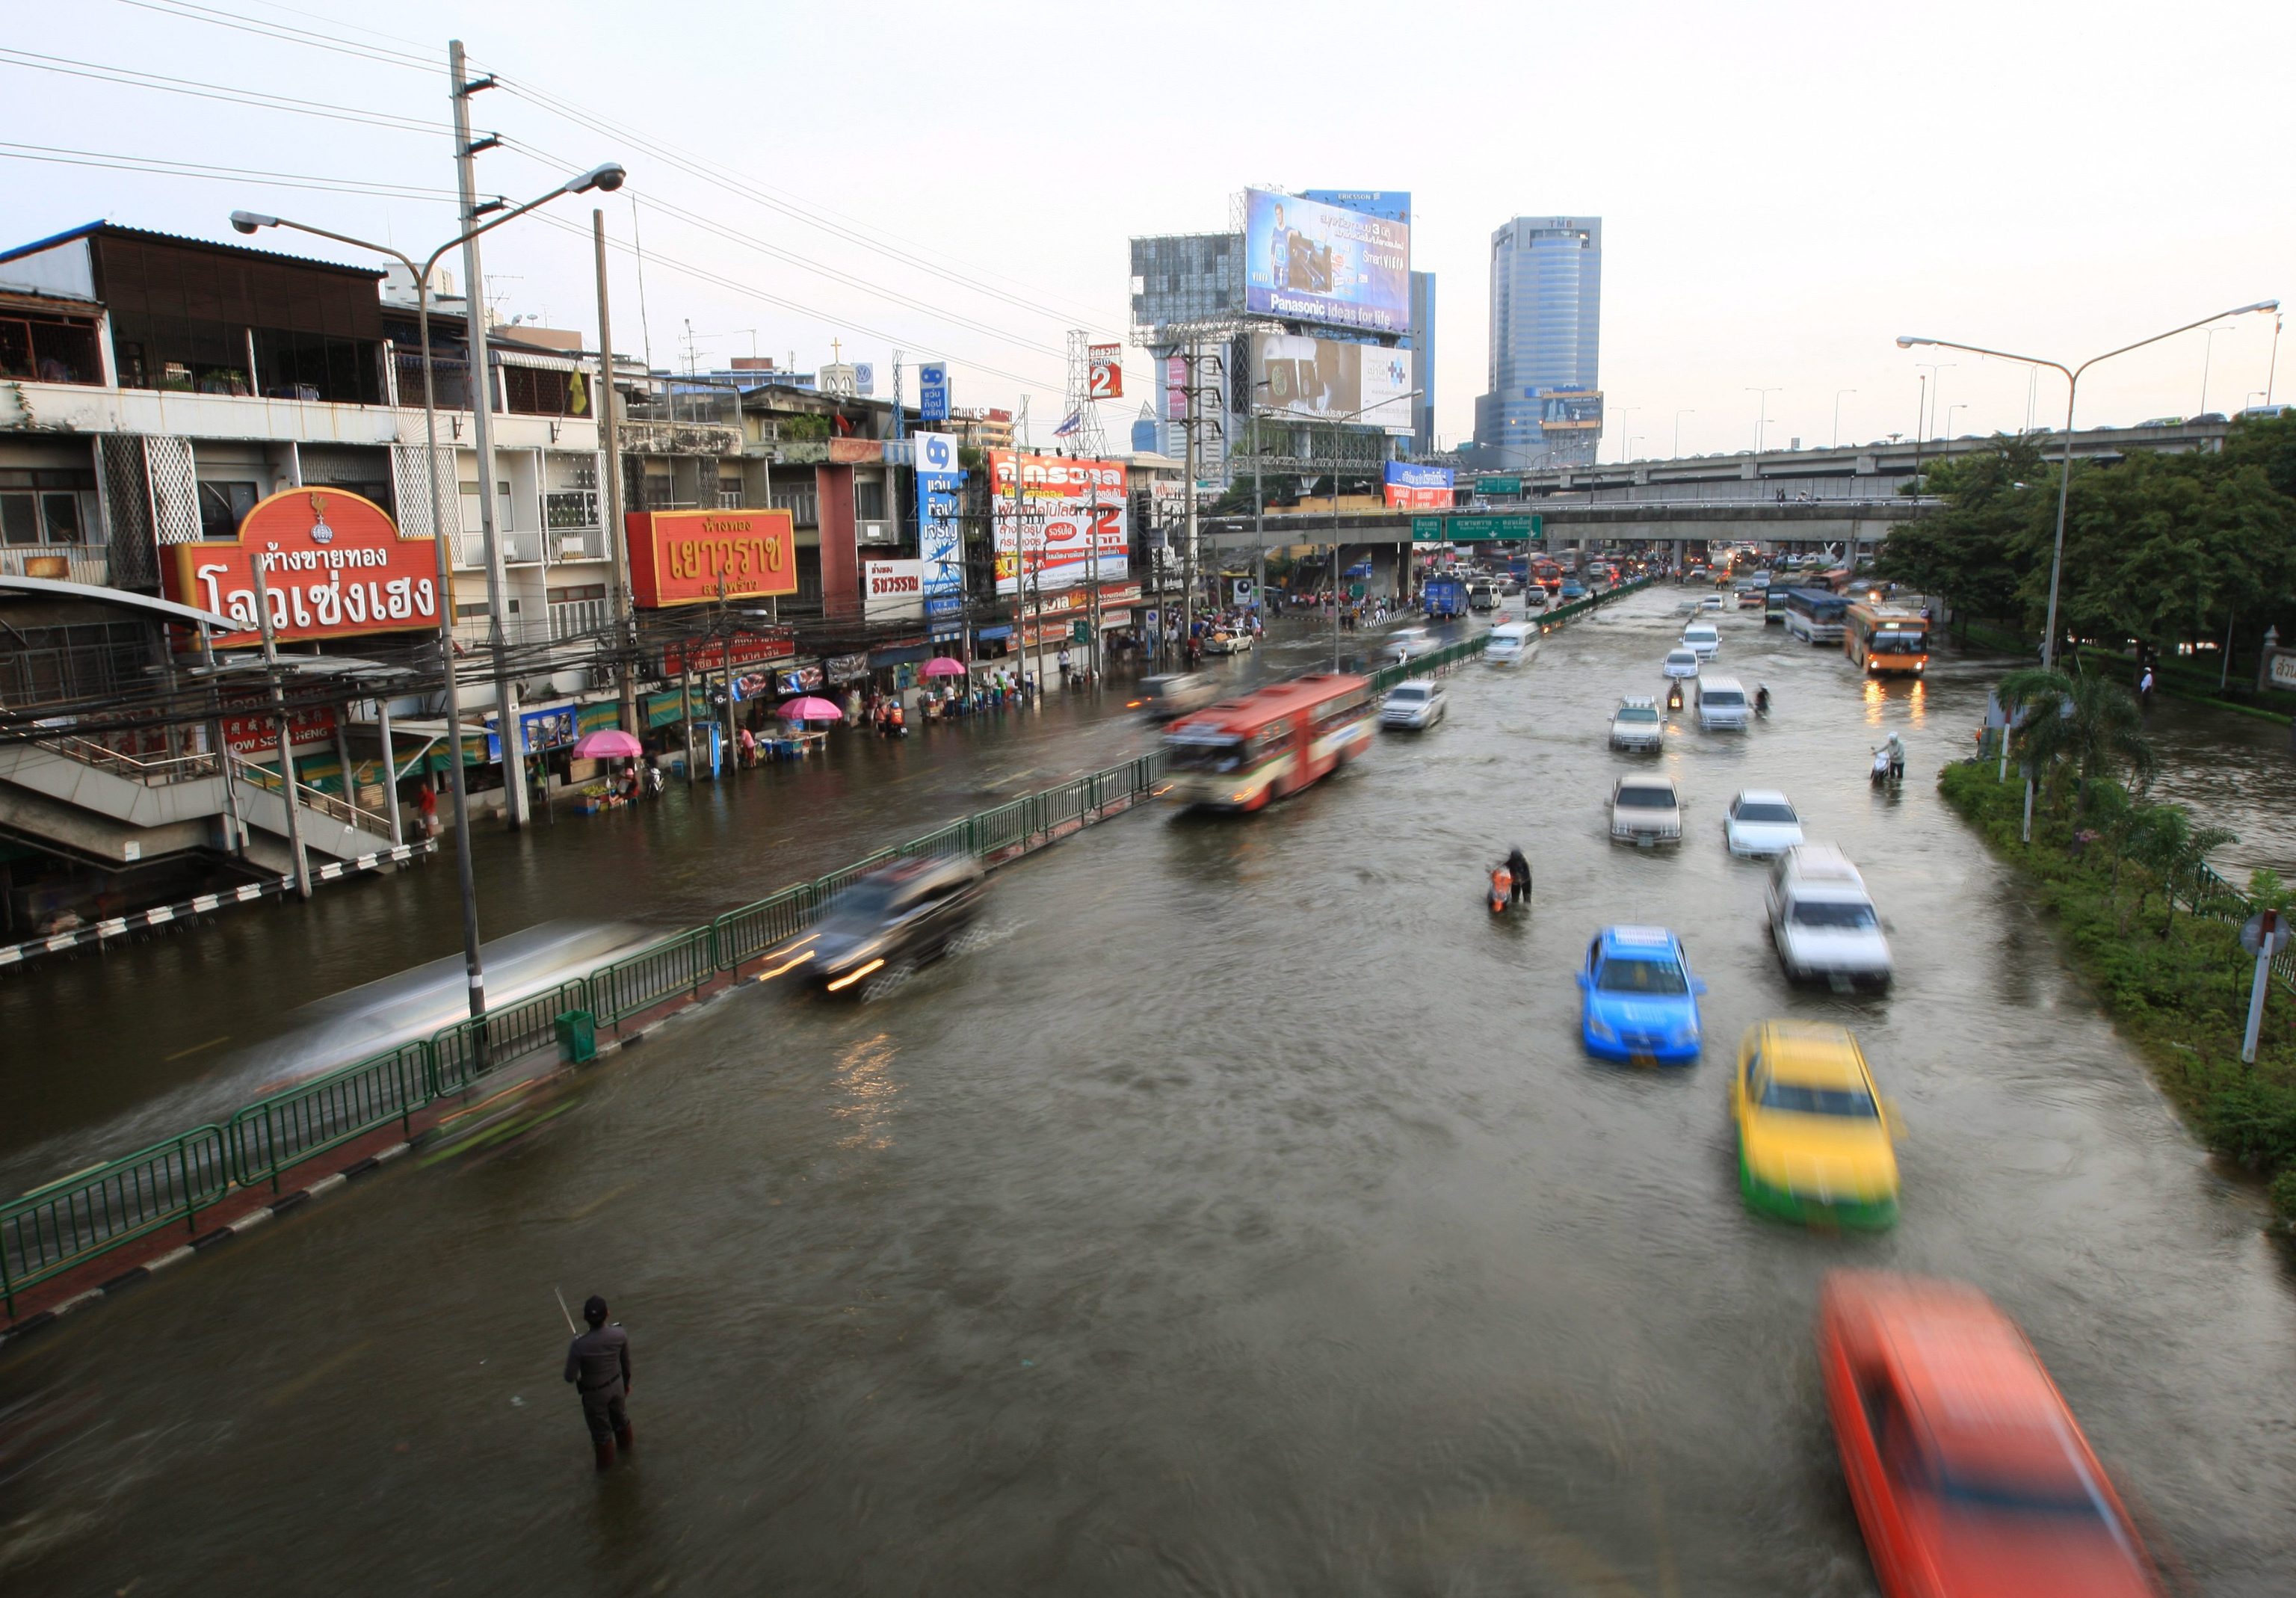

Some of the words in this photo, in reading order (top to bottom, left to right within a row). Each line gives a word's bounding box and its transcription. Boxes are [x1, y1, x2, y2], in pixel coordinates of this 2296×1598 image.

[1550, 220, 1572, 228] TMB
[1363, 250, 1383, 267] Smart
[1271, 293, 1325, 315] Panasonic
[1327, 304, 1356, 321] ideas
[1359, 308, 1373, 322] for
[1374, 311, 1391, 326] life
[1090, 347, 1120, 357] จักรวาล
[1092, 366, 1111, 396] 2
[925, 389, 940, 398] แว่น
[923, 408, 944, 418] เจริญ
[925, 399, 942, 408] ท็อป
[997, 456, 1121, 486] จักรวาล
[928, 475, 950, 493] แว่น
[928, 497, 952, 516] ท็อป
[703, 516, 752, 533] ห้างทอง
[1086, 502, 1120, 534] 2
[924, 519, 957, 541] เจริญ
[1049, 525, 1073, 537] รอรับได้
[260, 542, 386, 572] ห้างขายทอง
[670, 534, 783, 579] เยาวราช
[704, 576, 758, 595] ลาพร้าว
[231, 739, 256, 752] OW
[295, 727, 328, 741] HENG
